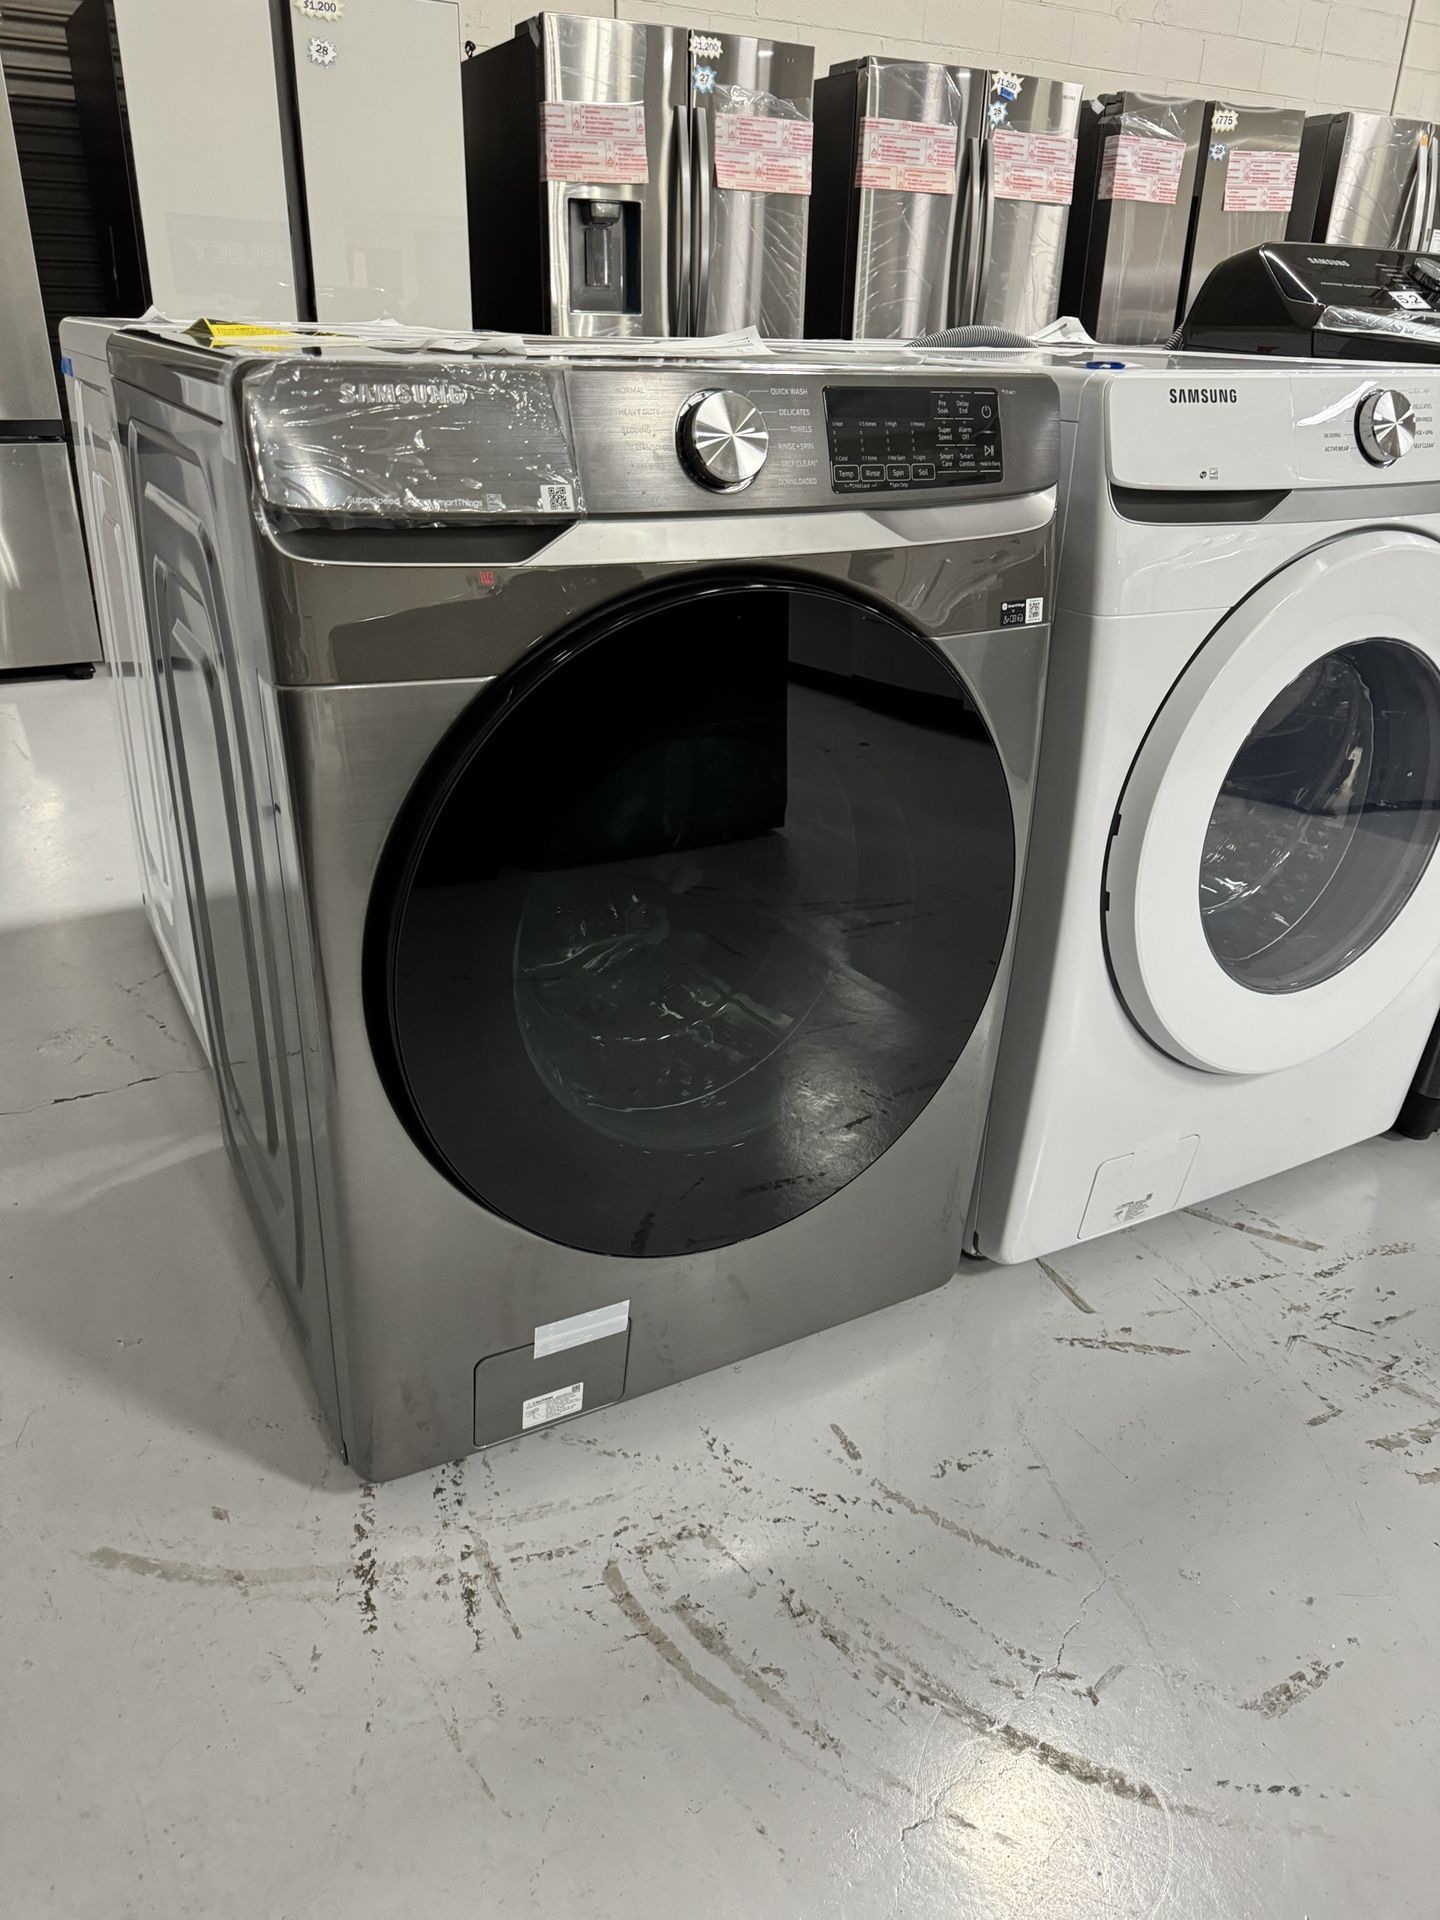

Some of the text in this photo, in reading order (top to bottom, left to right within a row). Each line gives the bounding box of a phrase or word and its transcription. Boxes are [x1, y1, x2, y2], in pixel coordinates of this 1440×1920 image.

[303, 0, 336, 12] $1,200
[315, 44, 328, 55] 28
[700, 73, 709, 83] 27
[1215, 116, 1233, 125] $775
[339, 383, 464, 404] SAMSUNG
[1169, 388, 1237, 403] SAMSUNG
[892, 469, 904, 477] Spin
